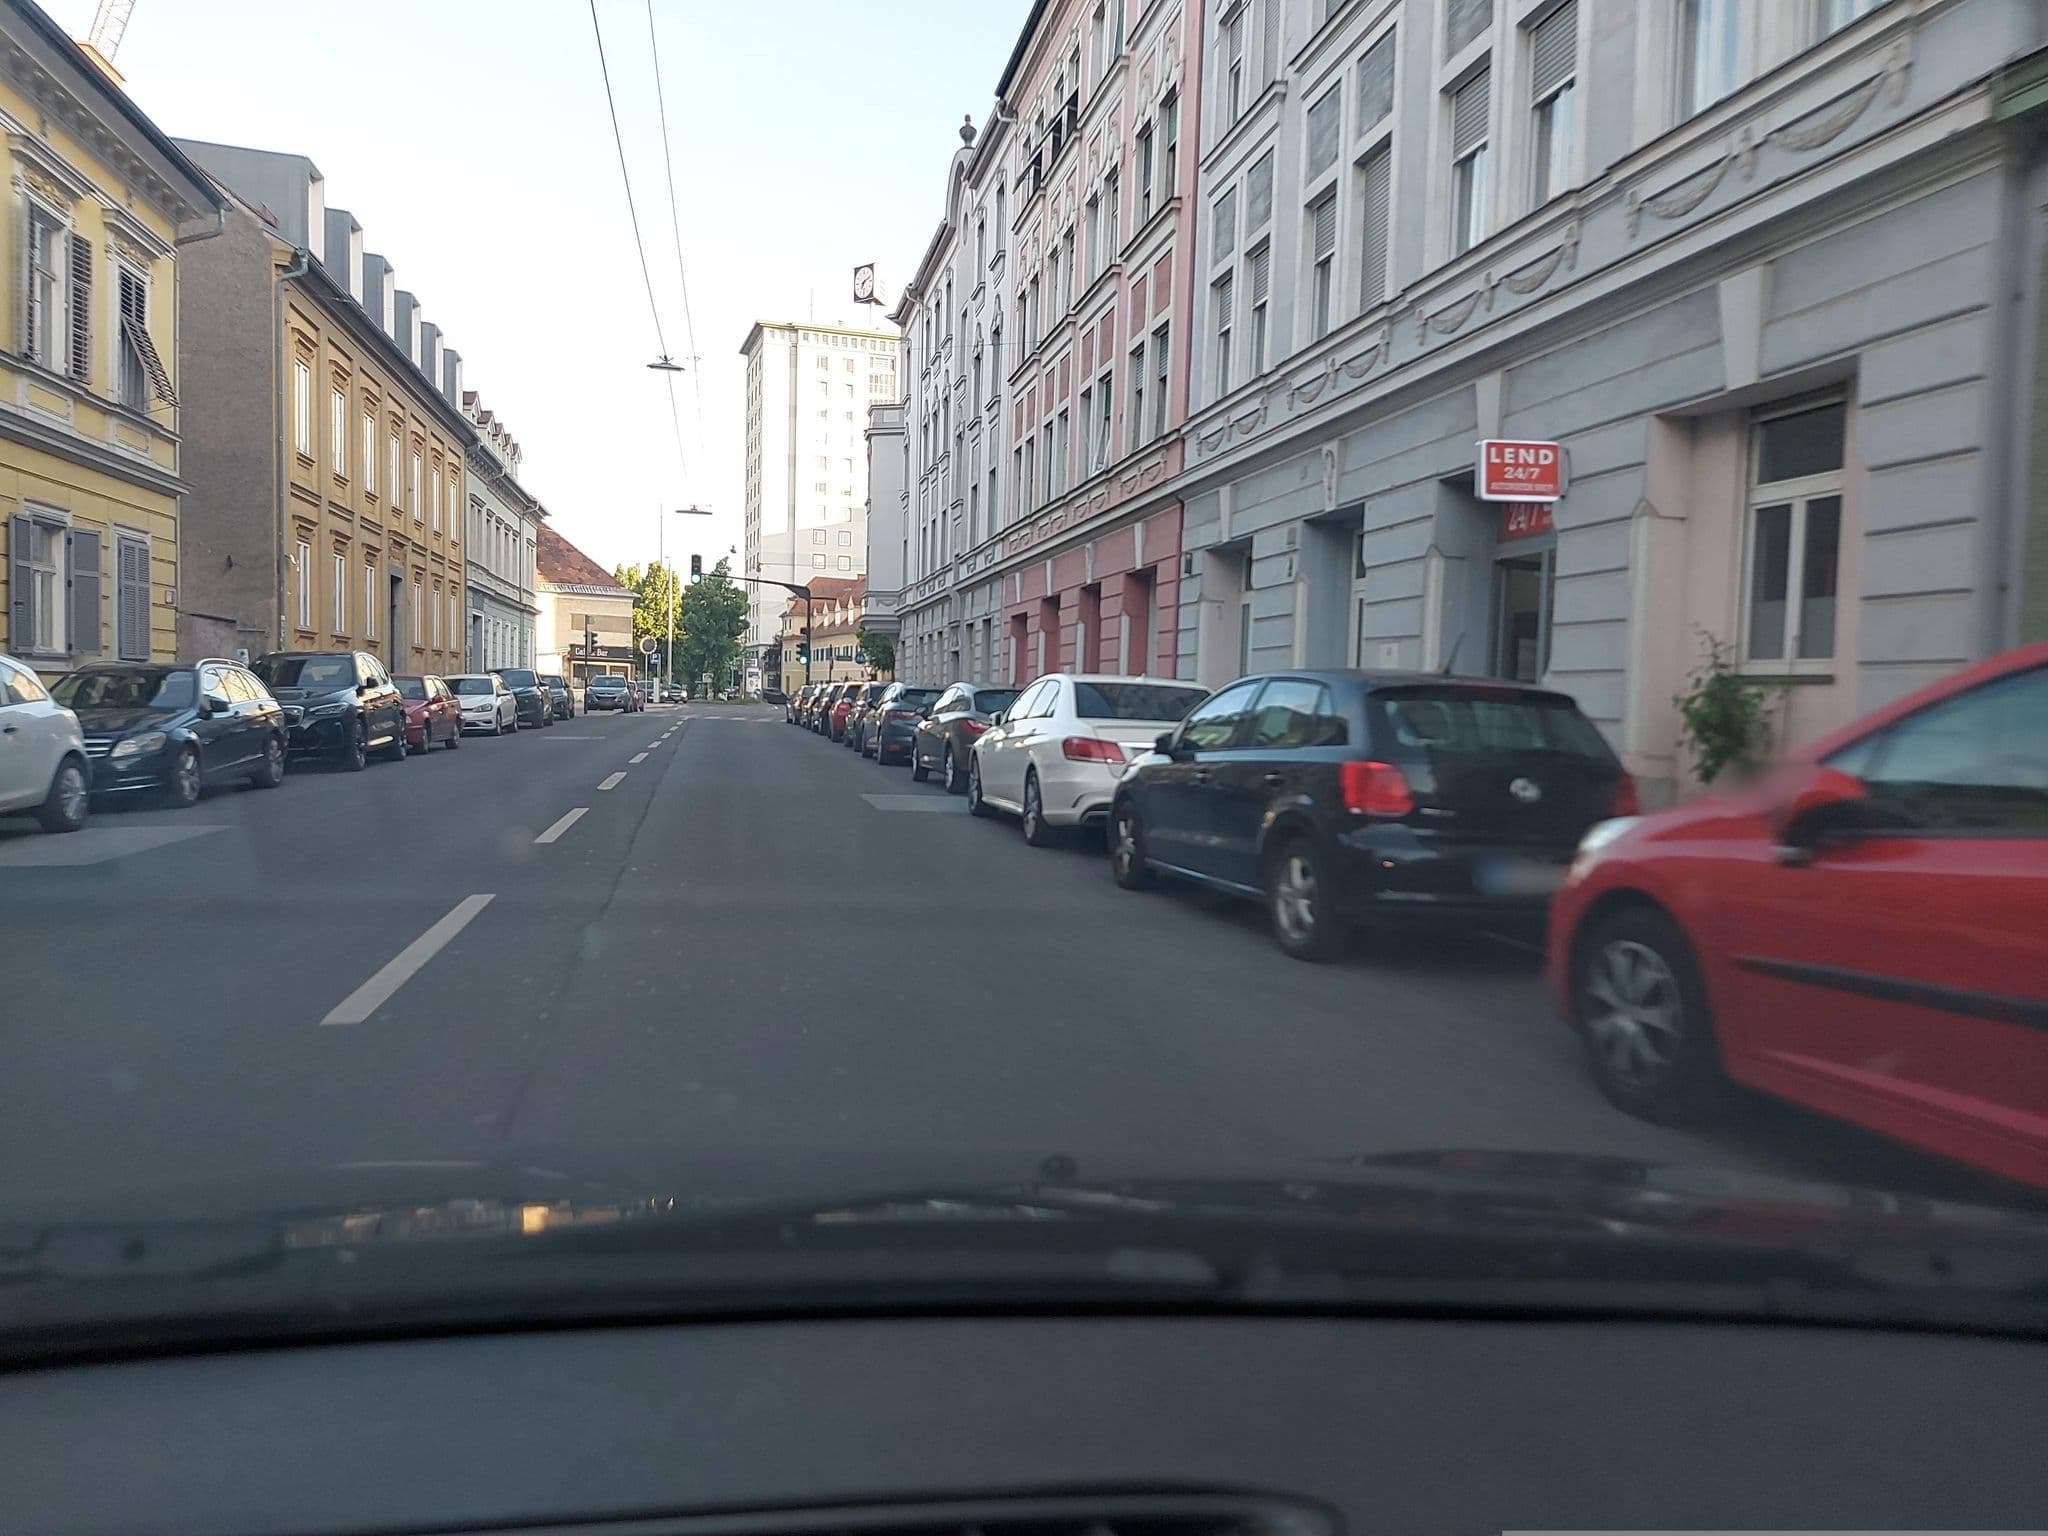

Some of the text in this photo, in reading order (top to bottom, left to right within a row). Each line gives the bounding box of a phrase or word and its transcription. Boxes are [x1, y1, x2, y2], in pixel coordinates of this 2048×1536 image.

[1489, 447, 1554, 465] LEND
[1503, 466, 1541, 480] 24/7
[596, 648, 609, 657] Bar
